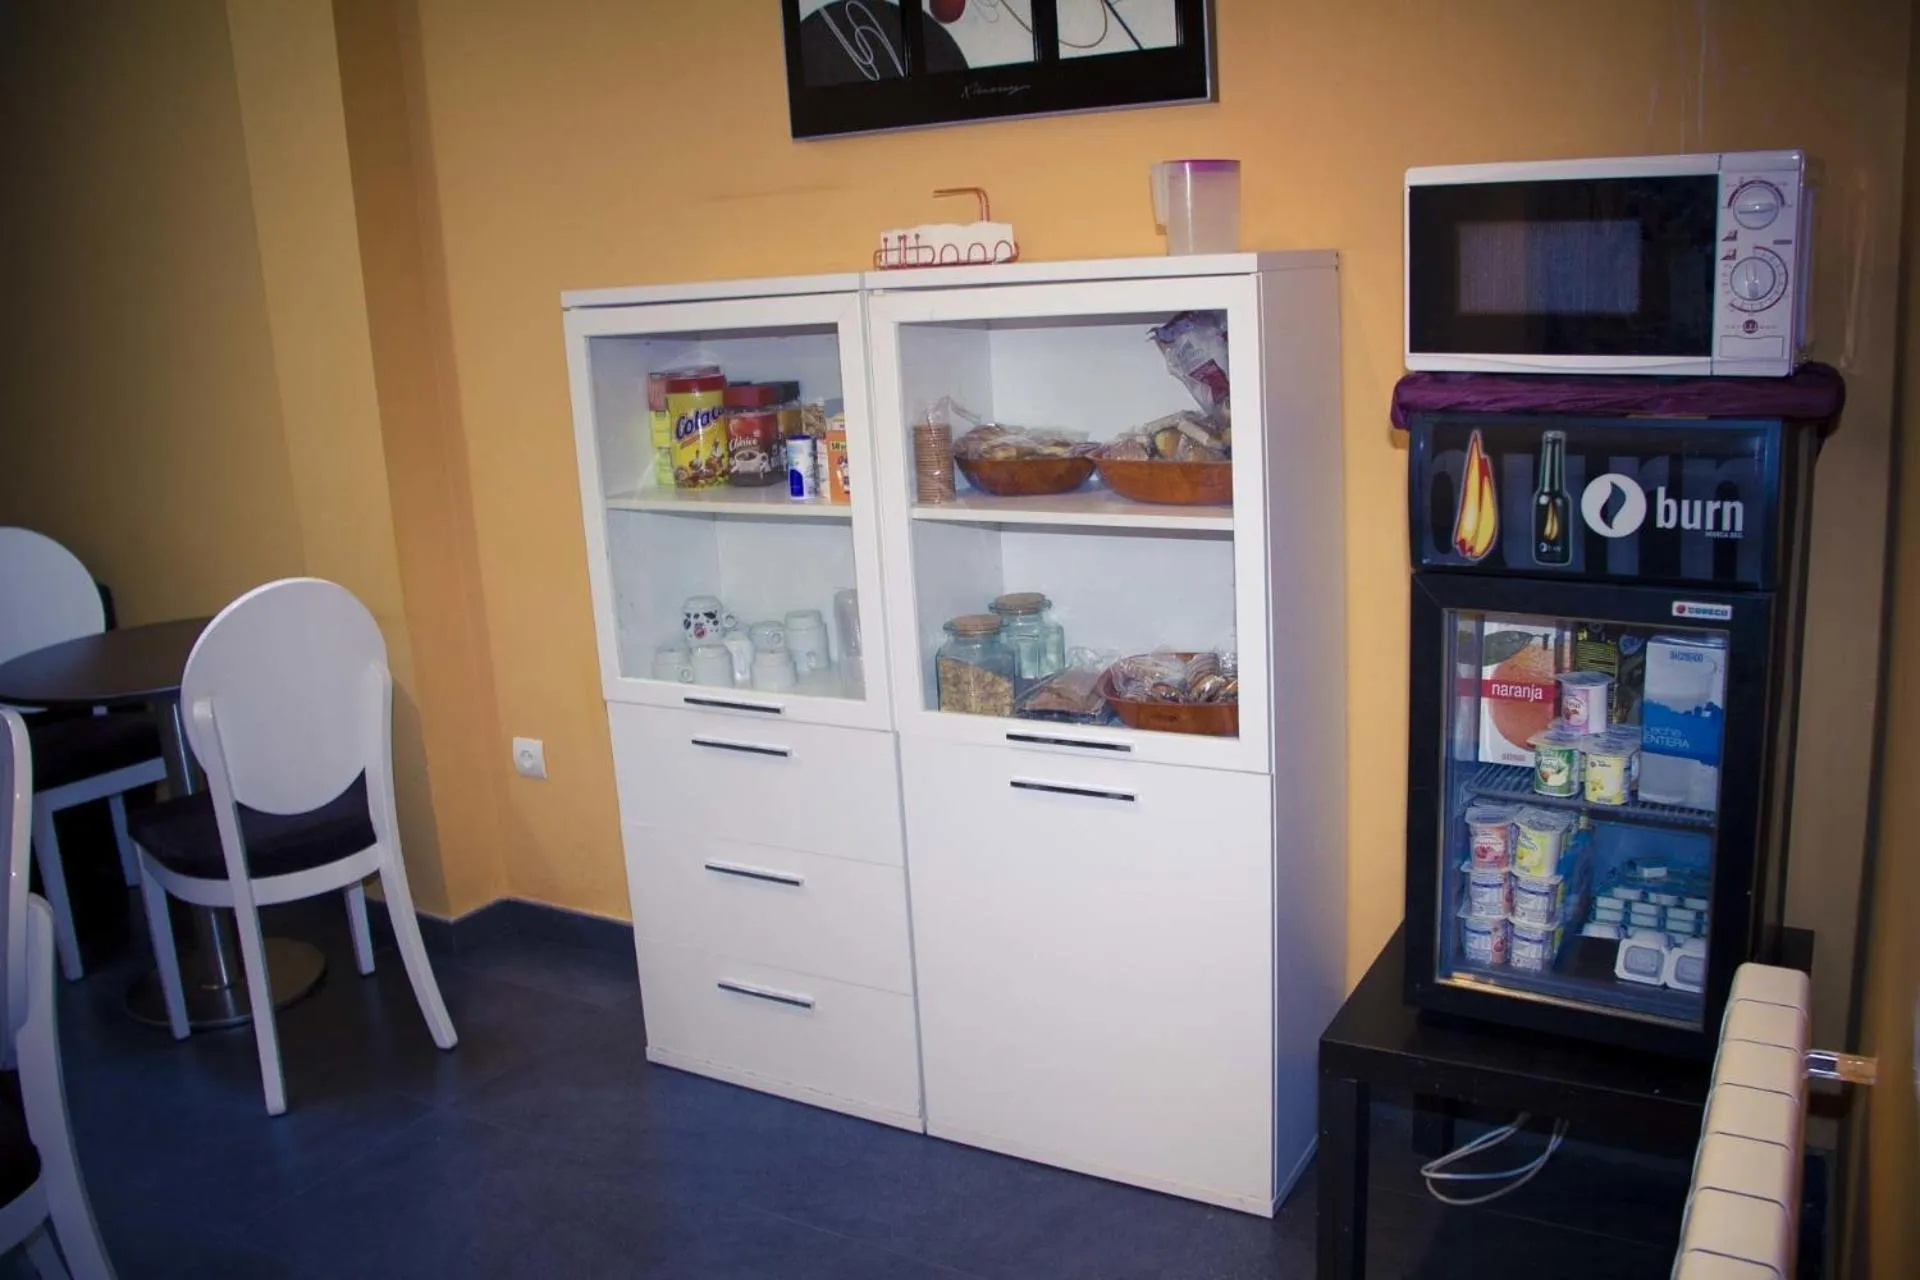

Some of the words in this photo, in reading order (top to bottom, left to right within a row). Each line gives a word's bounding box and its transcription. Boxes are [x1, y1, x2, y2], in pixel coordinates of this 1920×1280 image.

[1656, 486, 1744, 531] burn
[1491, 682, 1543, 702] naranja
[1643, 735, 1690, 749] ENTERA
